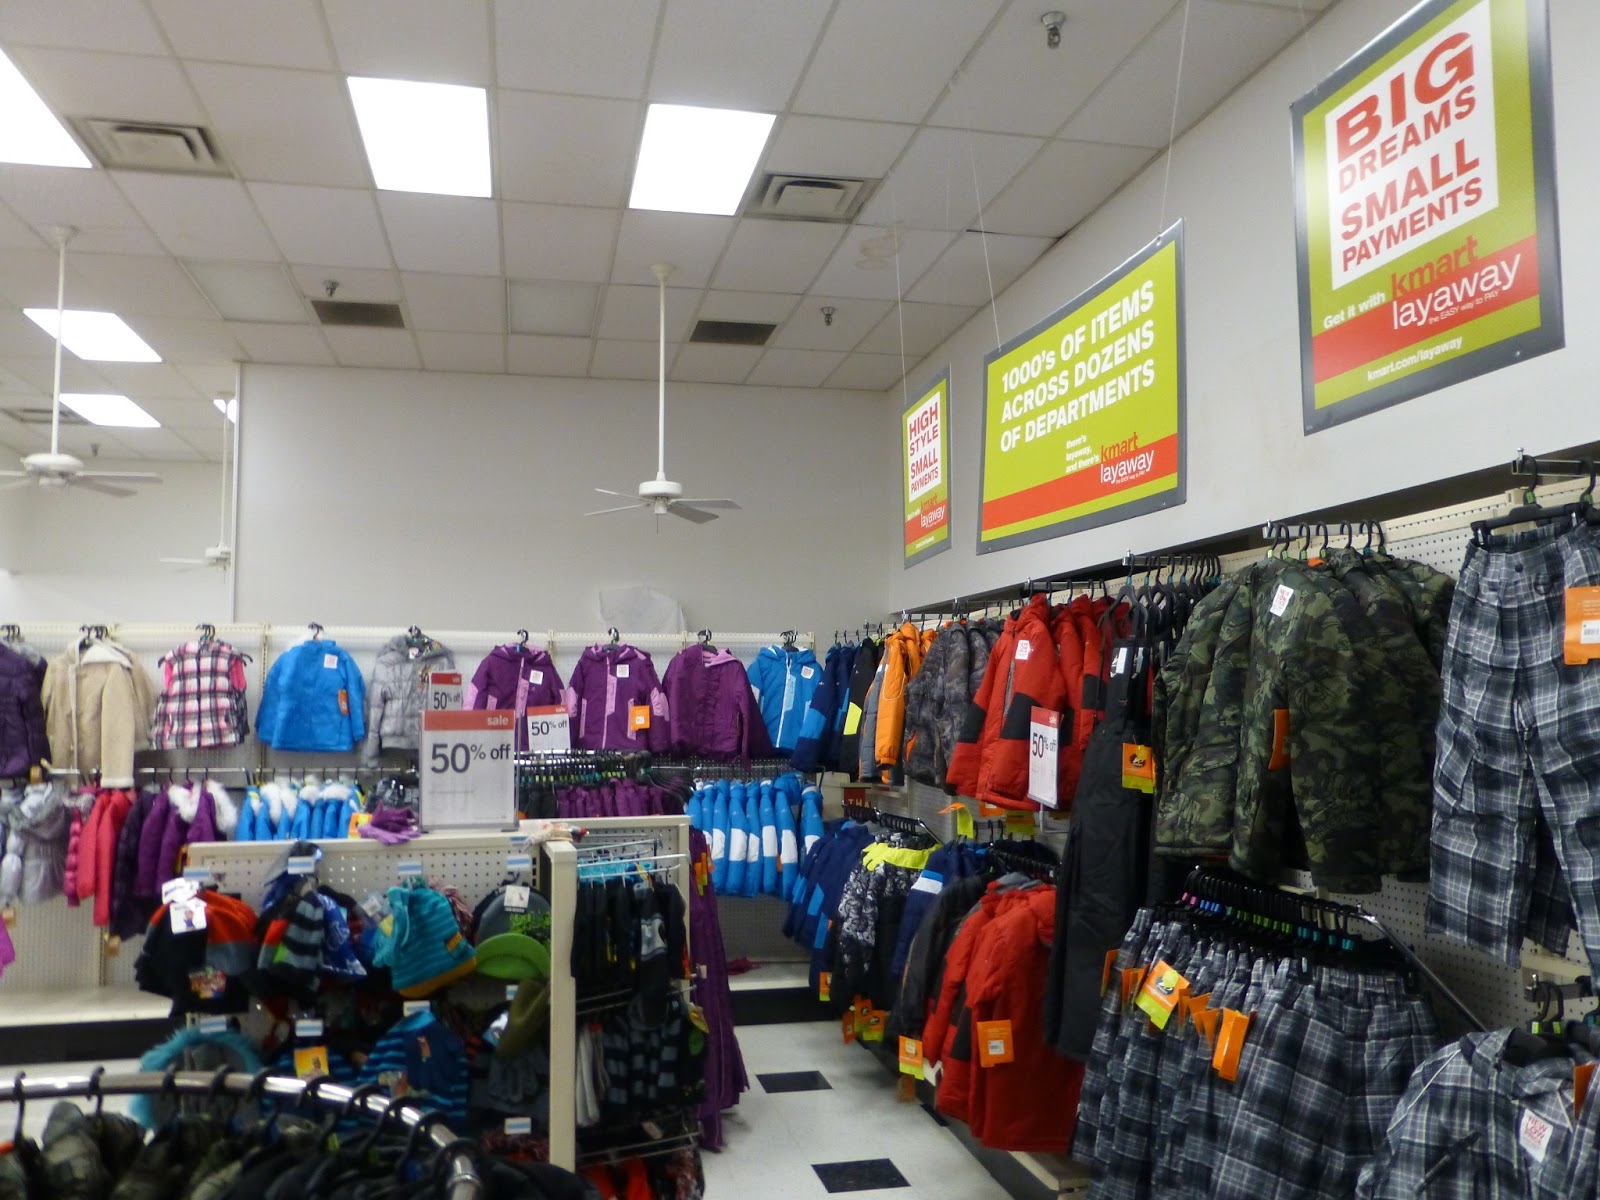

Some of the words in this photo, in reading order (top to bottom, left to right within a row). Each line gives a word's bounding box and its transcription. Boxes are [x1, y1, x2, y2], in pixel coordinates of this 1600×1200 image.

[1336, 31, 1475, 163] BIG
[1339, 85, 1476, 194] DREAMS
[1341, 138, 1480, 241] SMALL
[1342, 177, 1482, 272] PAYMENTS
[1391, 234, 1478, 297] kmart
[1392, 253, 1521, 330] layaway
[1440, 308, 1459, 320] EASY
[1484, 290, 1500, 302] PAY
[1323, 311, 1345, 329] Get
[1347, 304, 1357, 321] it
[1358, 291, 1386, 316] with
[1001, 350, 1056, 394] 1000's
[1060, 325, 1086, 361] OF
[1091, 280, 1154, 344] ITEMS
[1001, 369, 1069, 424] ACROSS
[1074, 319, 1155, 388] DOZENS
[1367, 336, 1463, 381] kmart.com/layaway
[909, 402, 938, 440] HIGH
[1000, 425, 1021, 453] OF
[1025, 358, 1155, 443] DEPARTMENTS
[909, 424, 938, 456] STYLE
[1100, 431, 1138, 462] kmart
[910, 447, 938, 479] SMALL
[911, 466, 938, 494] PAYMENTS
[1065, 462, 1077, 473] and
[1078, 454, 1099, 468] there's
[1100, 450, 1155, 484] layaway
[920, 505, 945, 528] layaway
[433, 692, 453, 710] 50%
[453, 693, 461, 702] off
[487, 714, 509, 726] sale
[531, 721, 557, 736] 50%
[557, 719, 568, 729] off
[431, 743, 487, 774] 50%
[490, 743, 511, 760] off
[1032, 732, 1049, 758] 50%
[1049, 740, 1057, 753] off
